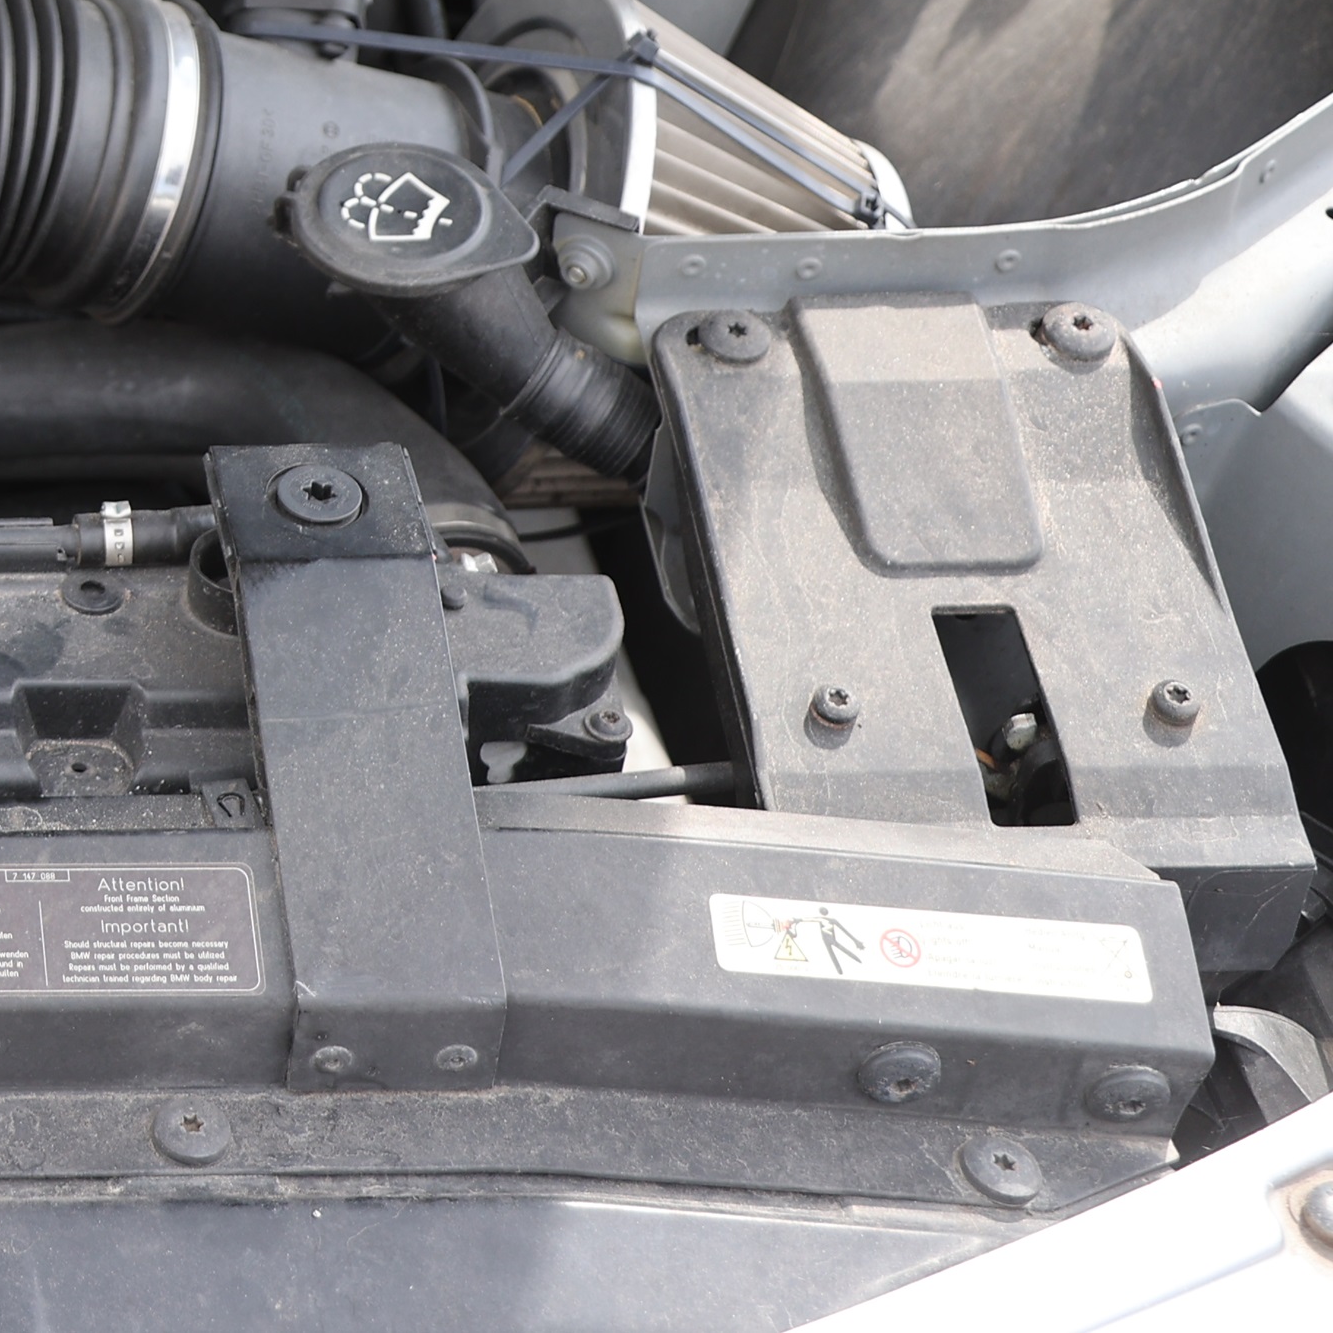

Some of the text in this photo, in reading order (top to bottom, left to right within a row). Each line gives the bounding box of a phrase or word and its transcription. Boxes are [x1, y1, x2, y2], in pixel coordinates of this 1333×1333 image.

[23, 872, 36, 880] 147
[98, 877, 185, 892] Attention!
[104, 895, 122, 903] Front
[127, 905, 154, 913] entirely
[158, 904, 166, 912] of
[101, 919, 188, 936] Important!
[64, 940, 229, 950] Should structural repairs become necessary
[71, 952, 90, 960] BMW
[94, 952, 115, 960] repair
[119, 952, 159, 960] procedures
[185, 951, 194, 959] be
[0, 960, 13, 968] und
[69, 963, 95, 972] Repairs
[99, 963, 116, 971] must
[120, 963, 130, 971] be
[134, 963, 172, 972] performed
[176, 963, 185, 972] by
[198, 962, 229, 971] qualified
[63, 974, 100, 982] technician
[104, 974, 128, 982] trained
[132, 974, 167, 984] regarding
[170, 974, 190, 982] BMW
[194, 973, 212, 983] body
